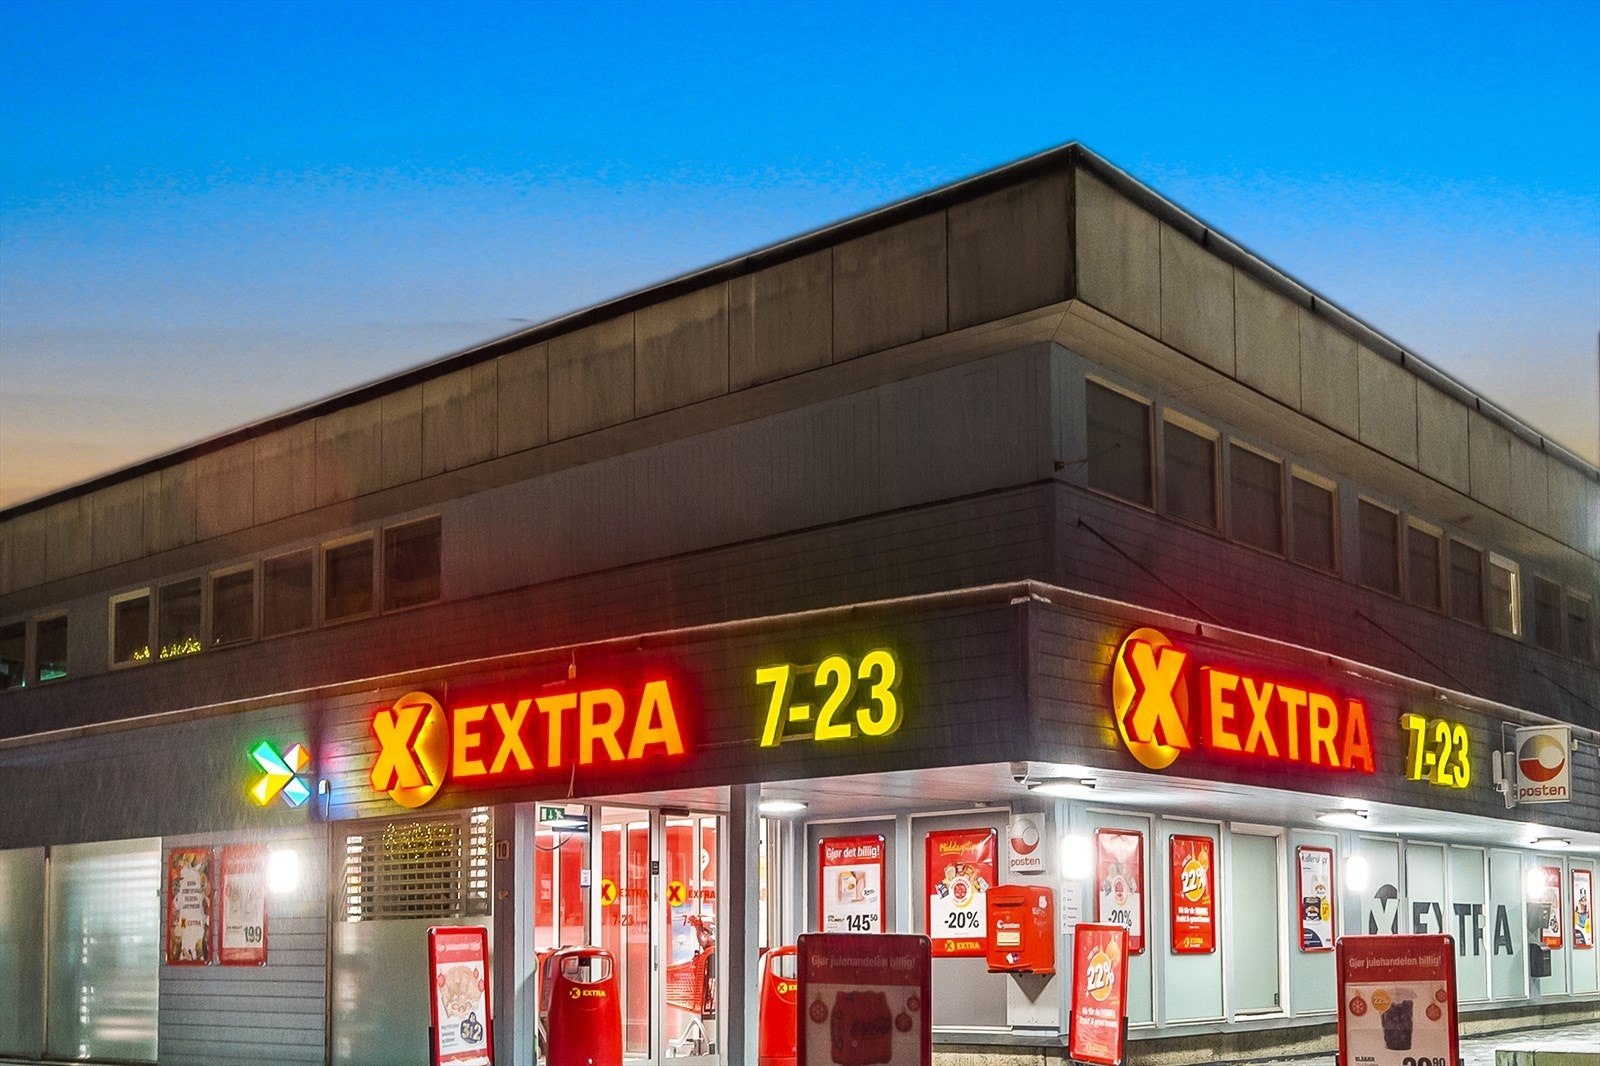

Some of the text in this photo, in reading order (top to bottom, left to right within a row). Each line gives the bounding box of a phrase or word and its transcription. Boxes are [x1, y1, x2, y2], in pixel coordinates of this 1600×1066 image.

[756, 650, 898, 748] 7-23
[452, 680, 685, 777] EXTRA
[1208, 667, 1376, 774] EXTRA
[1402, 714, 1472, 789] 7-23
[1519, 785, 1566, 800] posten
[826, 845, 880, 860] Gjør det billig!
[1010, 857, 1041, 868] posten
[688, 889, 716, 899] EXTRA
[846, 914, 871, 931] 145
[944, 911, 980, 929] -20%
[244, 926, 262, 943] 199
[956, 942, 980, 950] EXTRA
[1366, 956, 1418, 969] julehandelen
[1418, 955, 1442, 967] billig!
[1087, 961, 1115, 991] 22%
